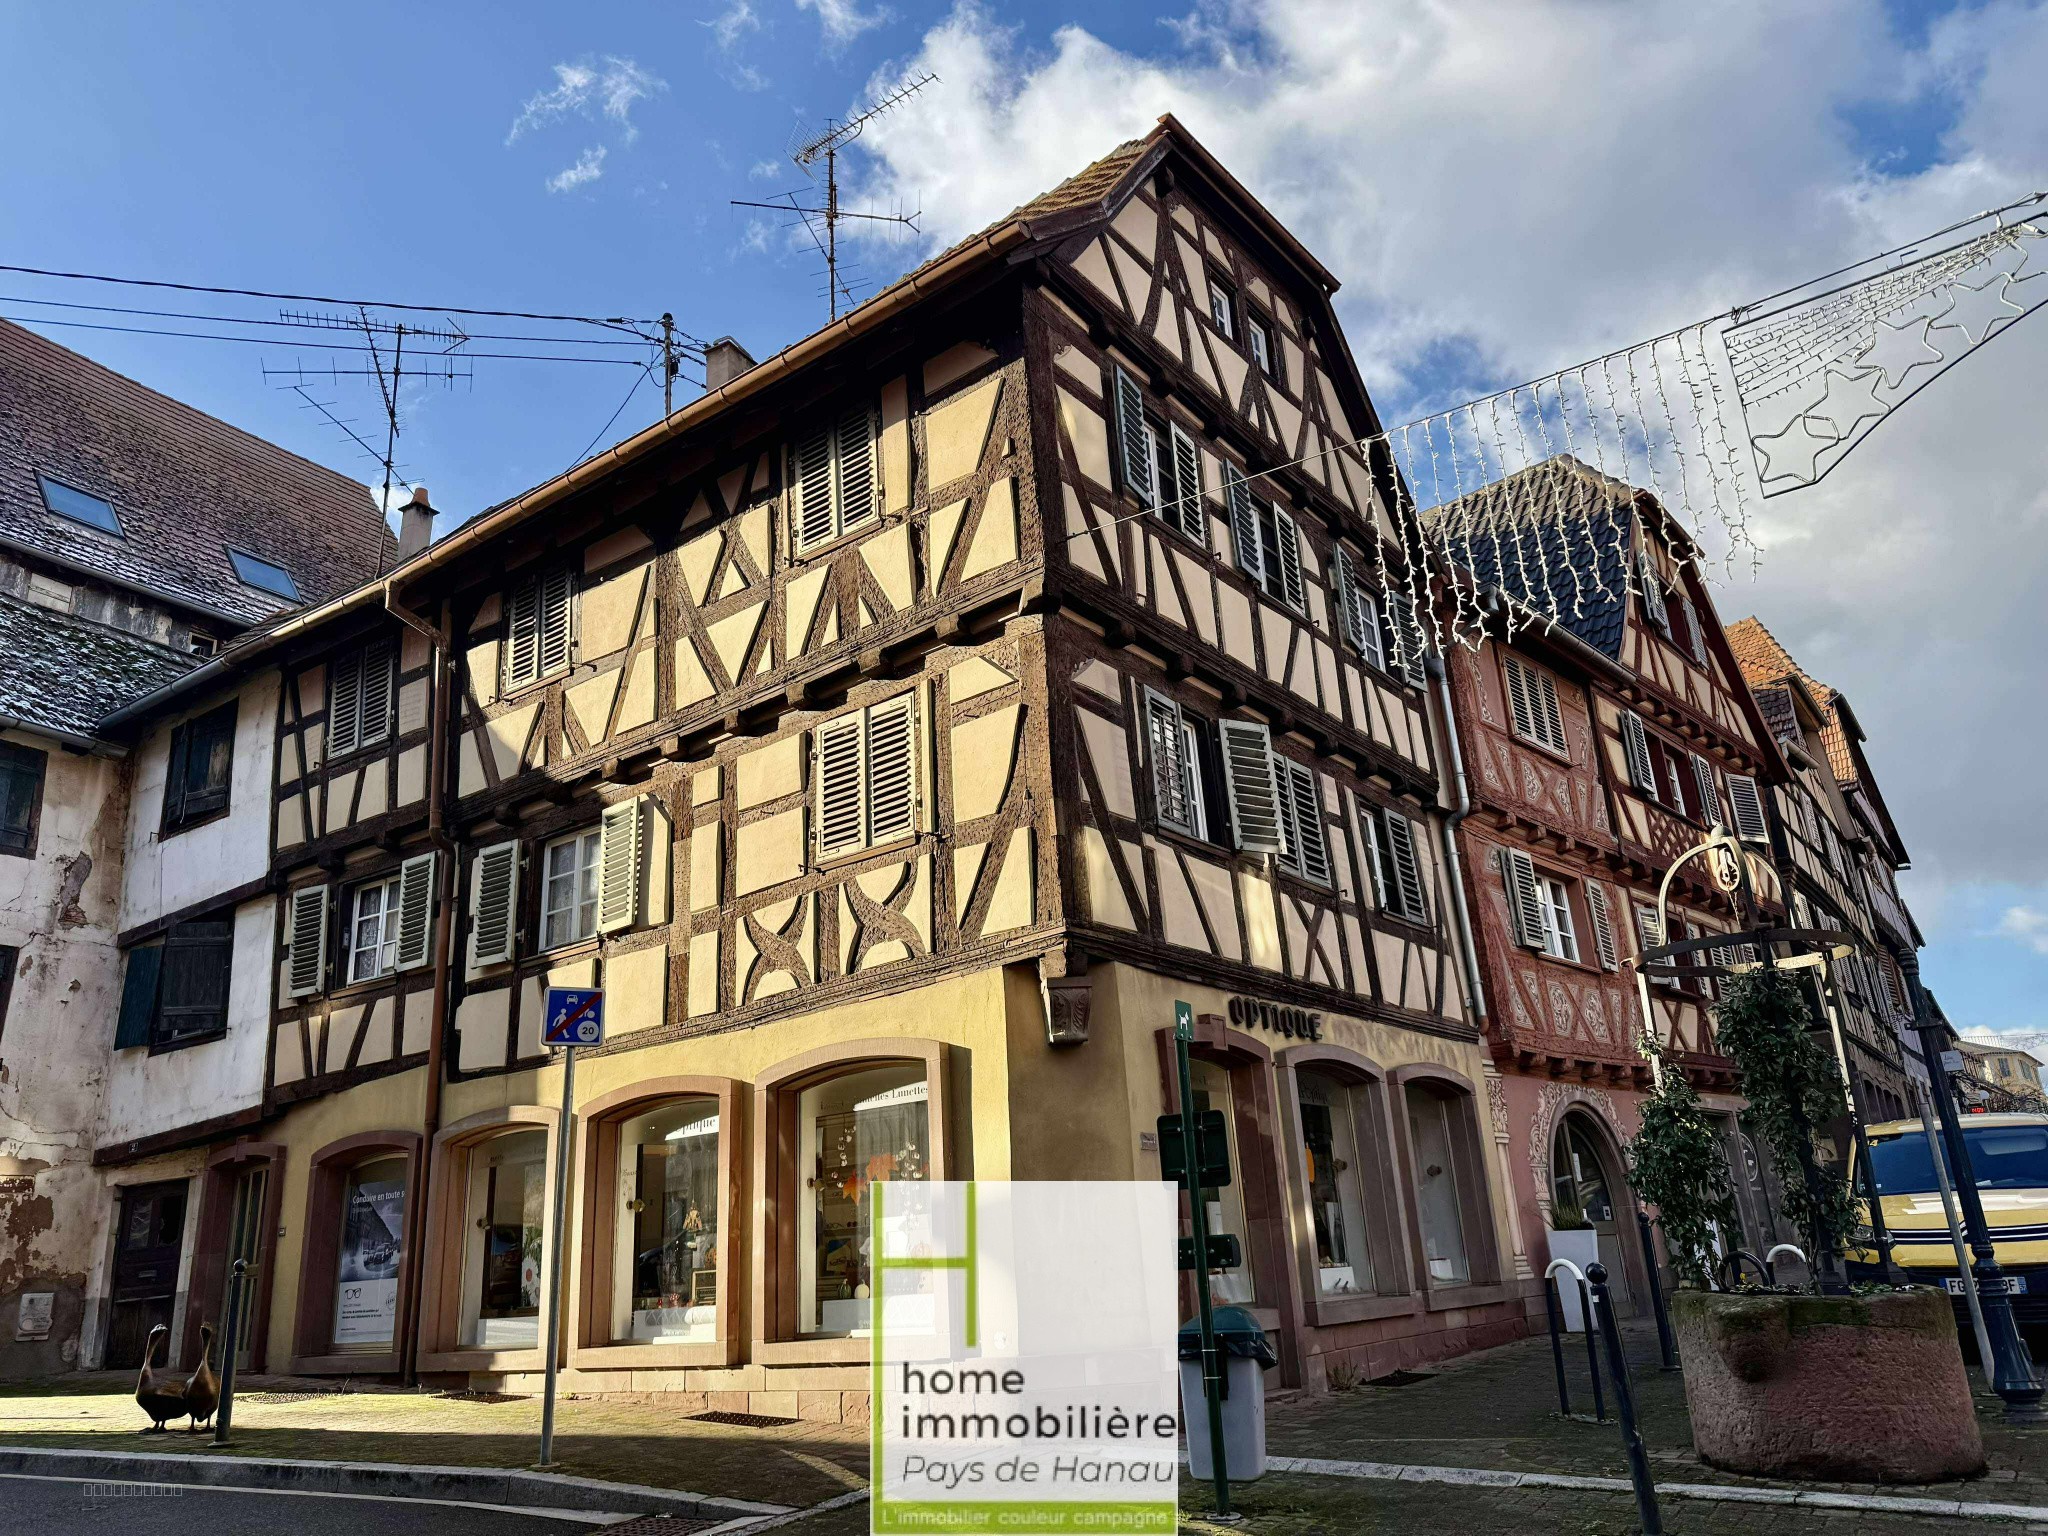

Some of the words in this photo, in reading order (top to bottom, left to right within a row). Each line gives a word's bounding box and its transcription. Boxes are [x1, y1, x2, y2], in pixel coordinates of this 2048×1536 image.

[1228, 995, 1323, 1041] OPTIQUE
[582, 1027, 594, 1035] 20
[385, 1191, 400, 1200] toute
